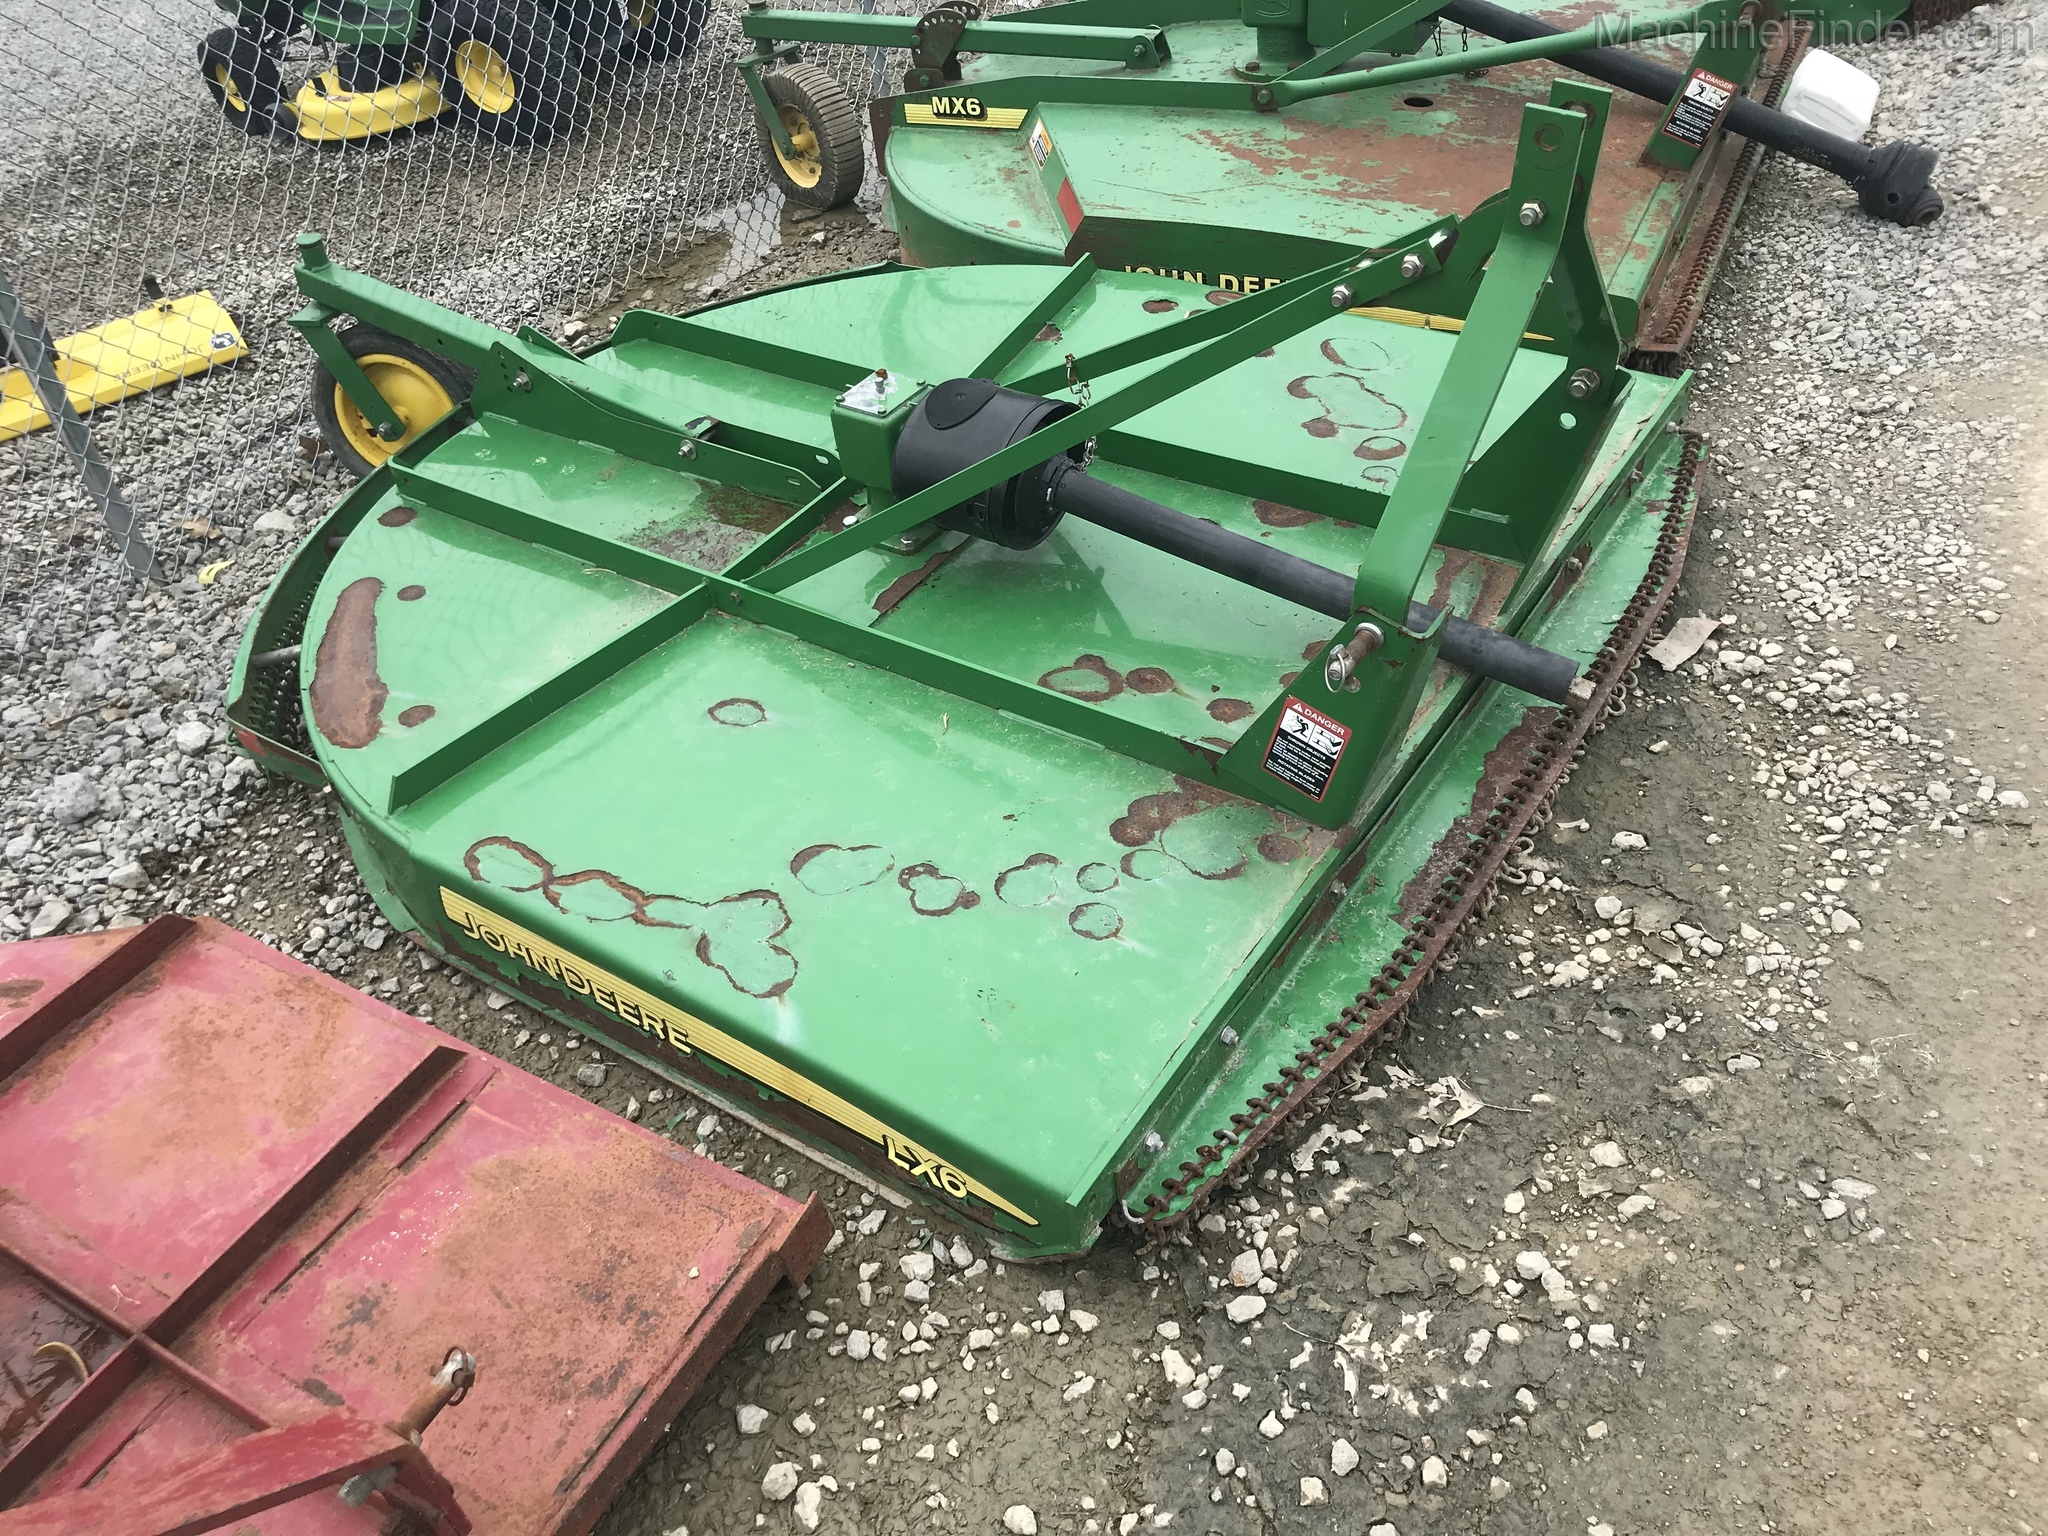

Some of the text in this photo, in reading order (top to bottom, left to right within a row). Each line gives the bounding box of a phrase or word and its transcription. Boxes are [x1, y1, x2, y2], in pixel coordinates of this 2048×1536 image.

[1705, 74, 1733, 90] DANGER
[931, 96, 982, 116] MX6
[1304, 708, 1345, 736] DANGER
[464, 913, 692, 1054] JOHN DEERE
[883, 1134, 968, 1198] LX6
